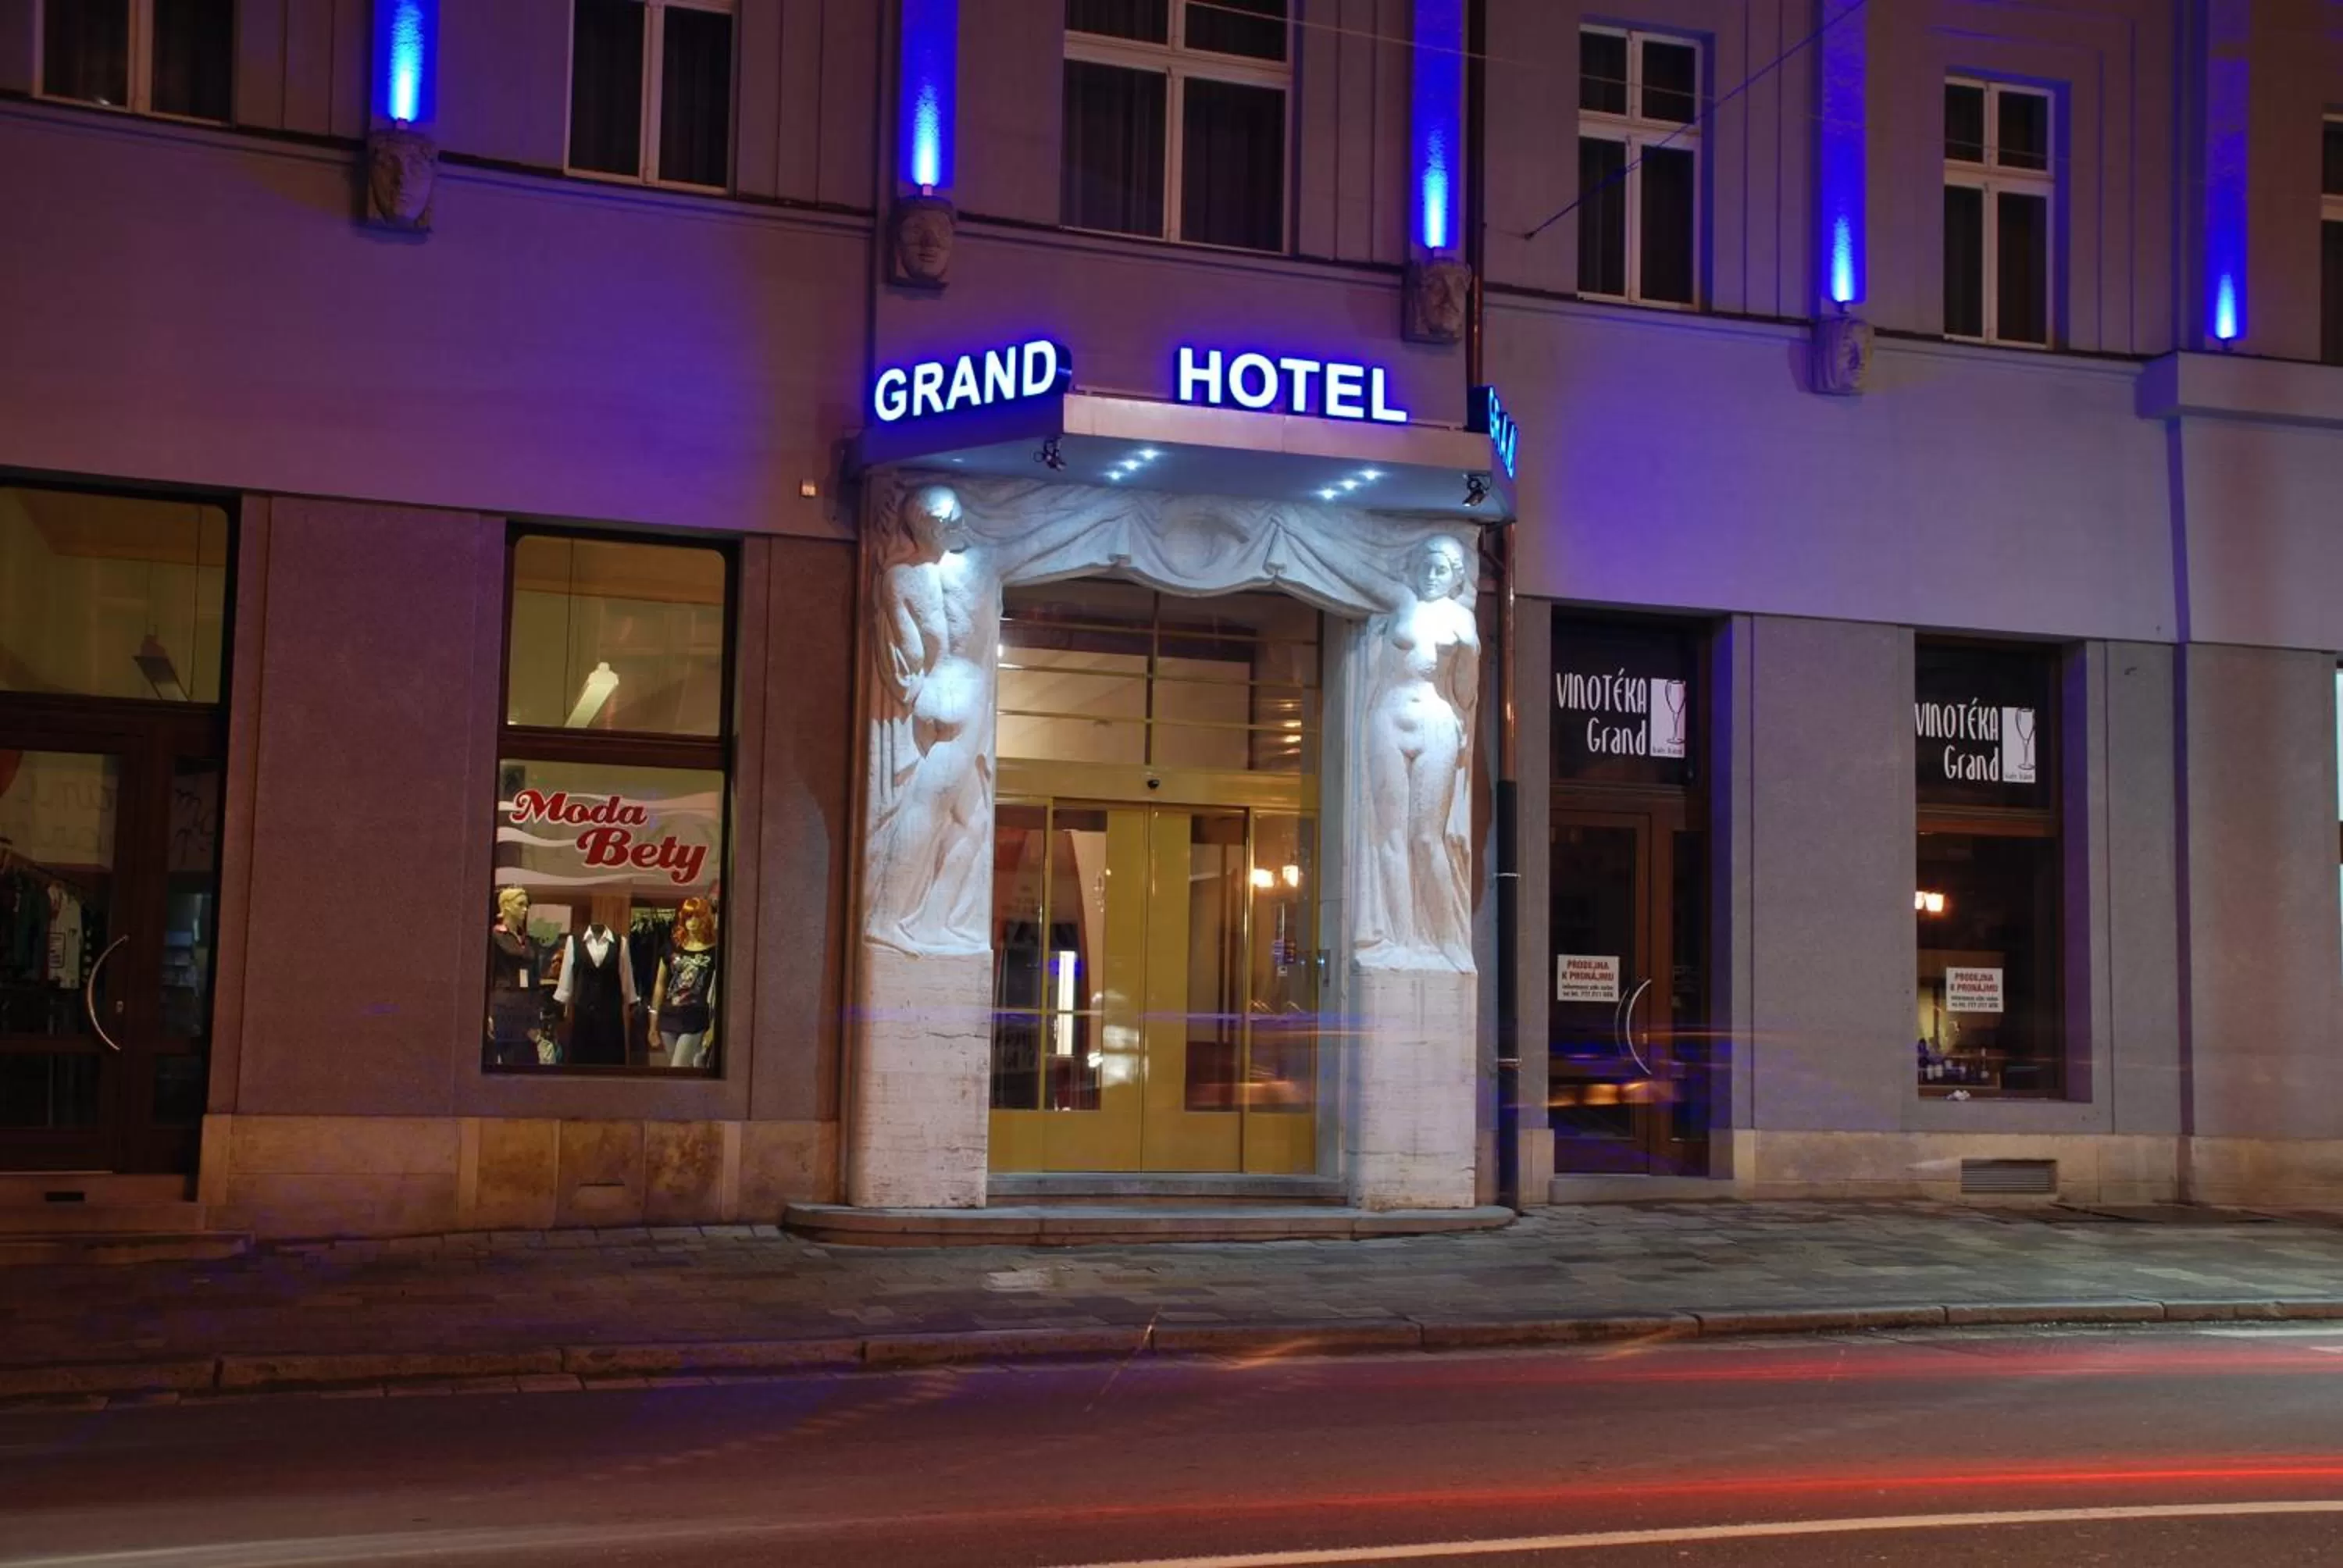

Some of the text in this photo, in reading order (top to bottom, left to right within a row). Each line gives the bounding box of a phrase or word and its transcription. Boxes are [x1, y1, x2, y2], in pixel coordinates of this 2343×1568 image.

[875, 340, 1407, 422] GRAND HOTEL
[1556, 668, 1647, 714] VINOTÉKA
[1587, 717, 1646, 755] Grand
[1914, 697, 1999, 741] VINOTÉKA
[1944, 744, 1999, 782] Grand
[509, 789, 648, 825] Moda
[576, 827, 708, 885] Bety
